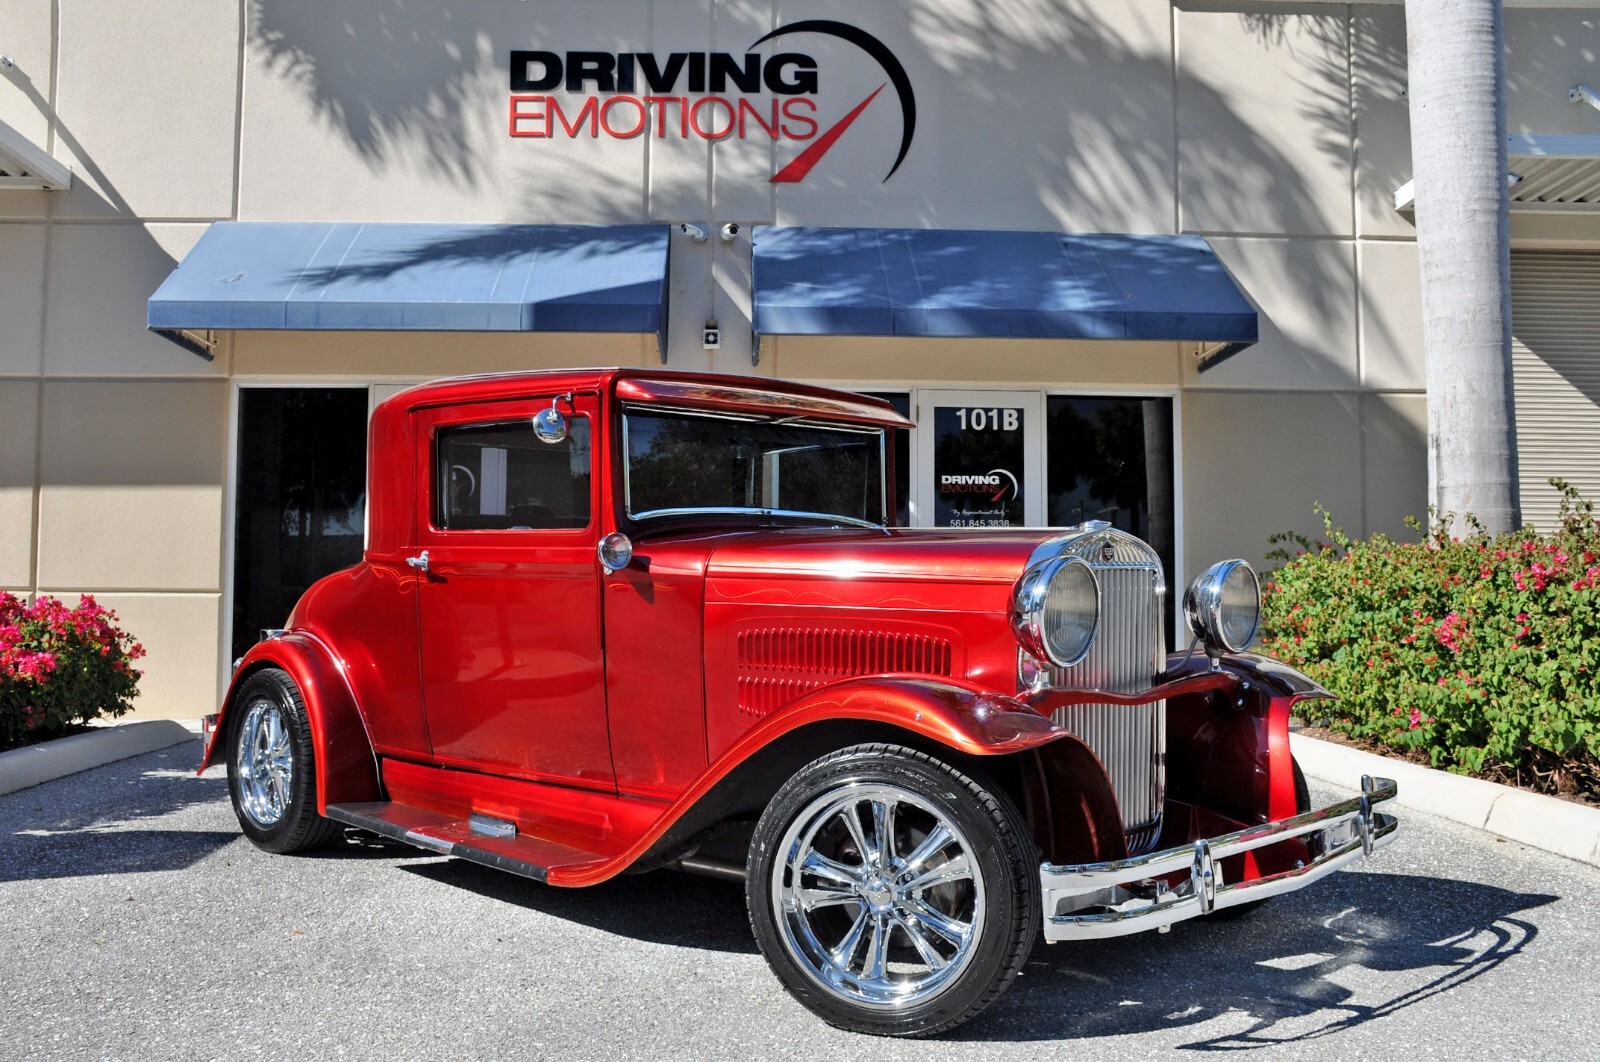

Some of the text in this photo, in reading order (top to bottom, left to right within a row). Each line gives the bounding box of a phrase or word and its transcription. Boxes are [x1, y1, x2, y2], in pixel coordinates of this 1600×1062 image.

[510, 50, 818, 95] DRIVING
[509, 96, 819, 140] EMOTIONS
[956, 408, 1019, 431] 101B
[941, 475, 1000, 485] DRIVING
[940, 484, 1000, 493] EMOTIONS
[950, 519, 1010, 527] 561.845.3838
